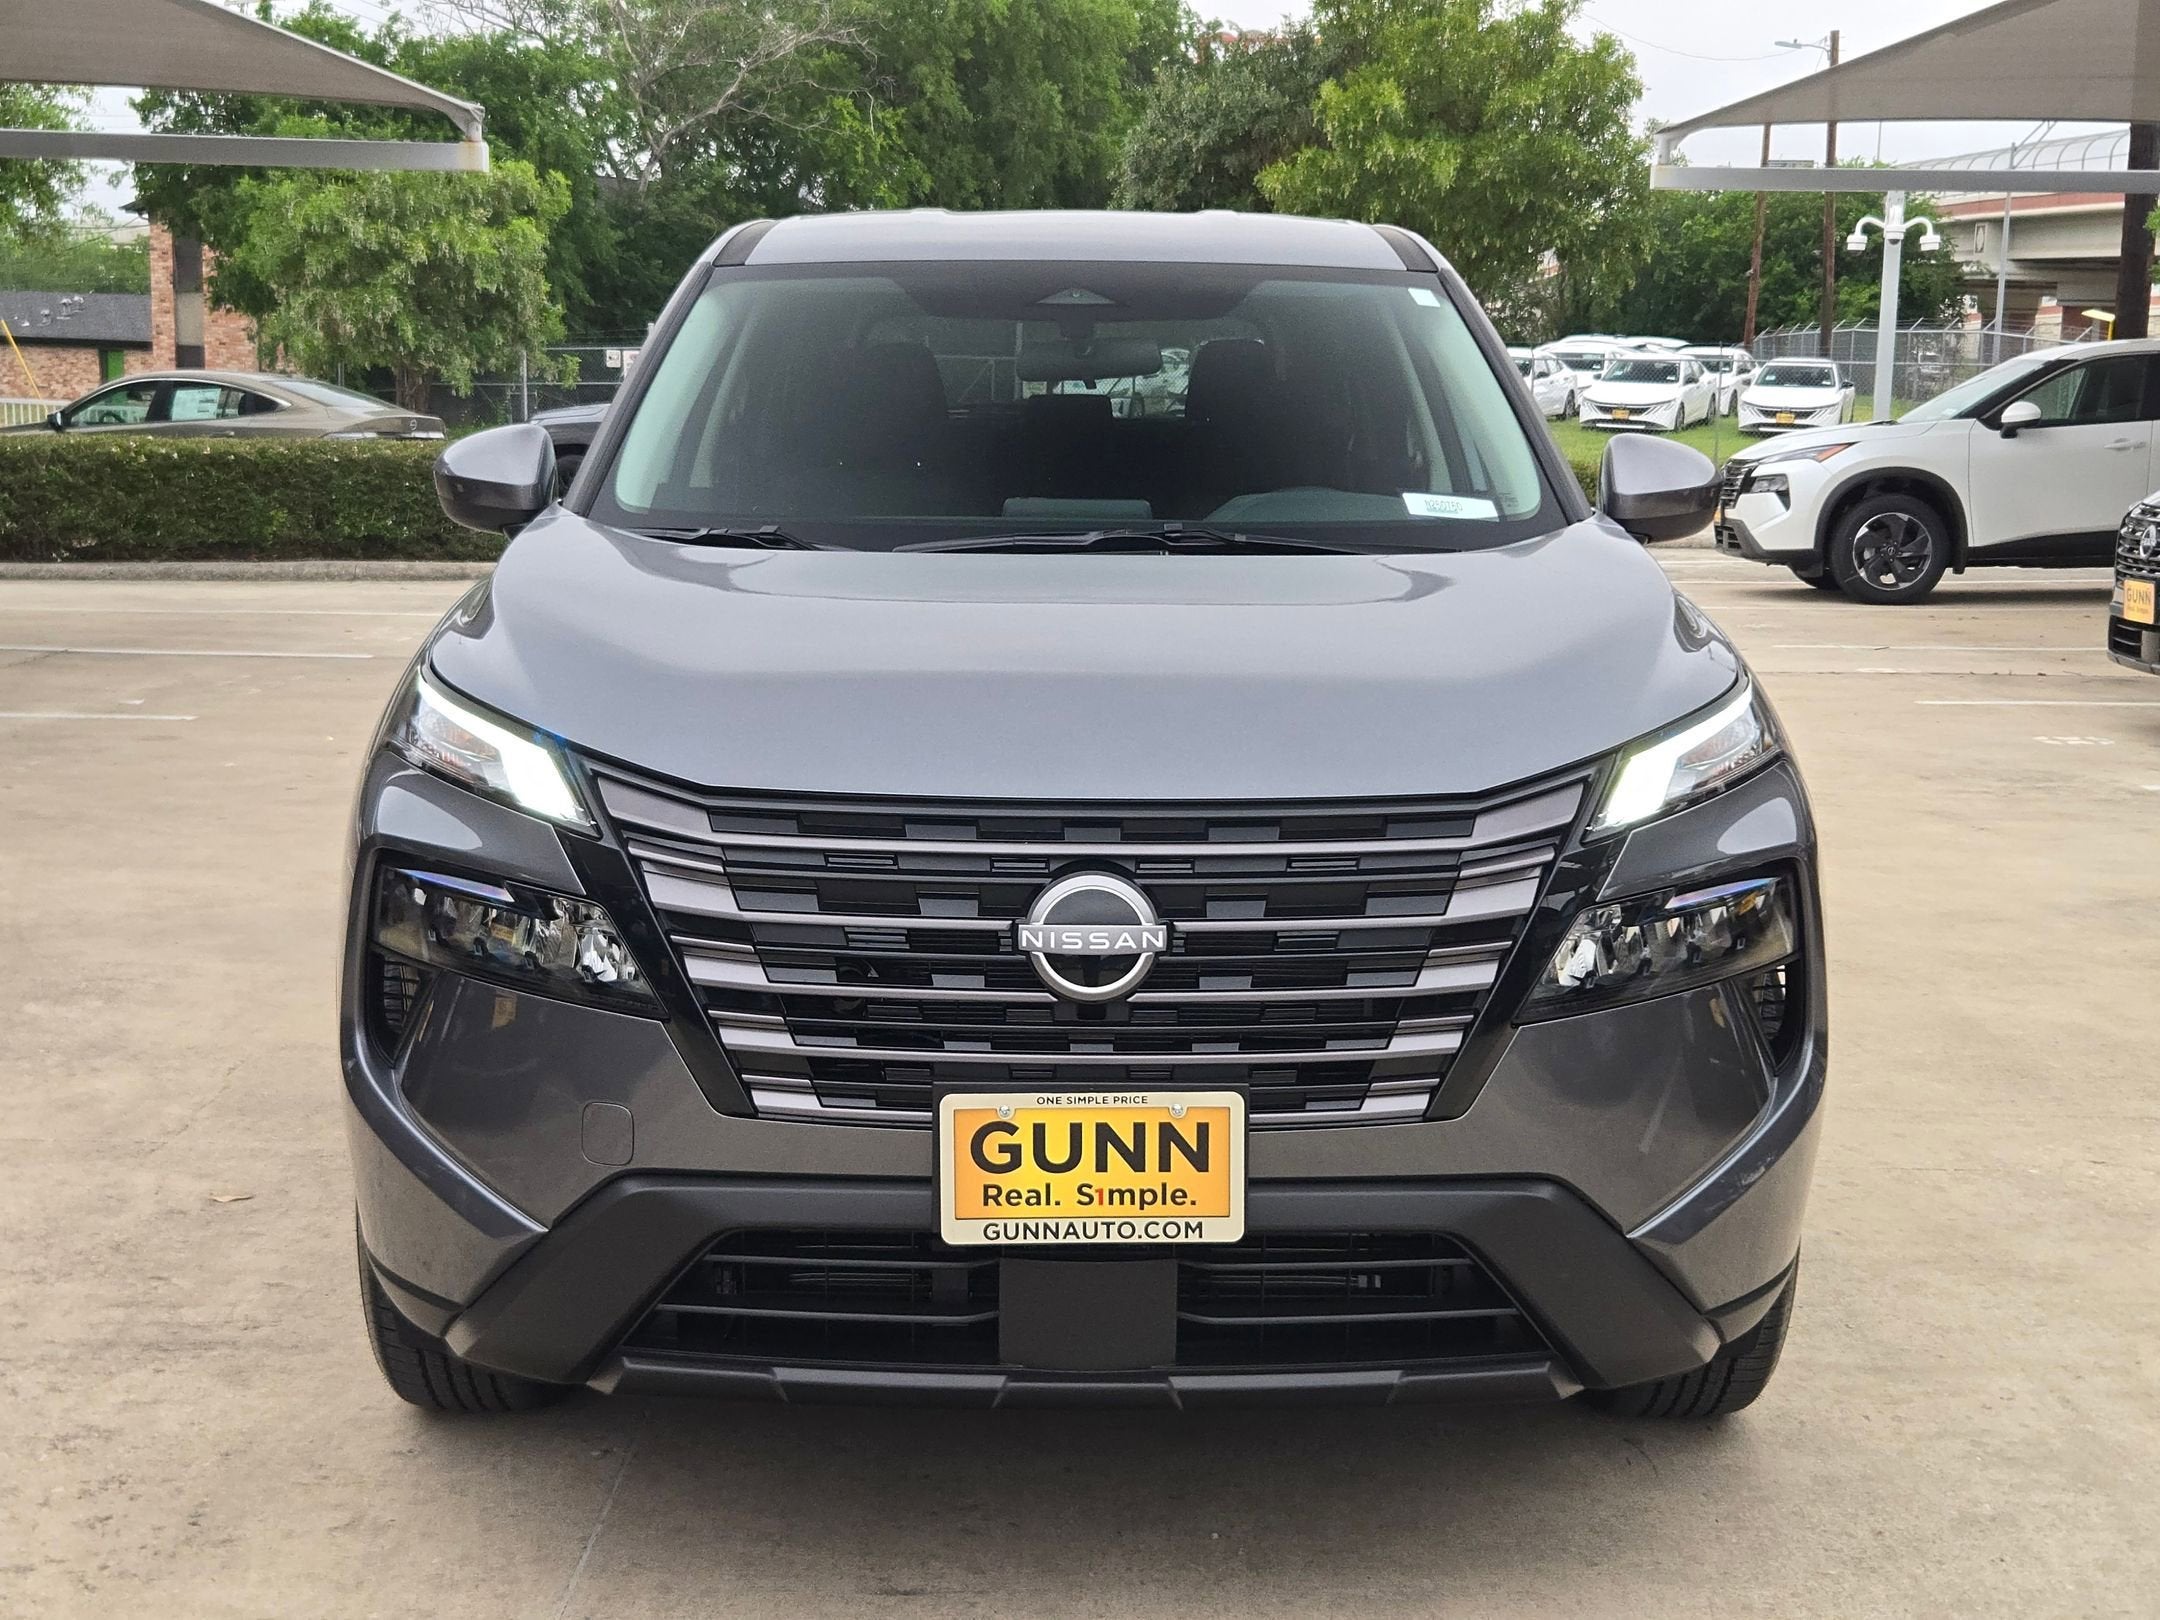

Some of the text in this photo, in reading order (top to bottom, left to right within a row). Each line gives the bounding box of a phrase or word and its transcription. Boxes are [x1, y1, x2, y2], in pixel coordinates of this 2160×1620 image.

[2127, 587, 2152, 605] GUNN
[1021, 930, 1163, 950] NISSAN
[1036, 1095, 1148, 1105] ONE SIMPLE PRICE
[970, 1120, 1209, 1174] GUNN
[982, 1182, 1061, 1207] Real.
[983, 1220, 1203, 1241] GUNNAUTO.COM
